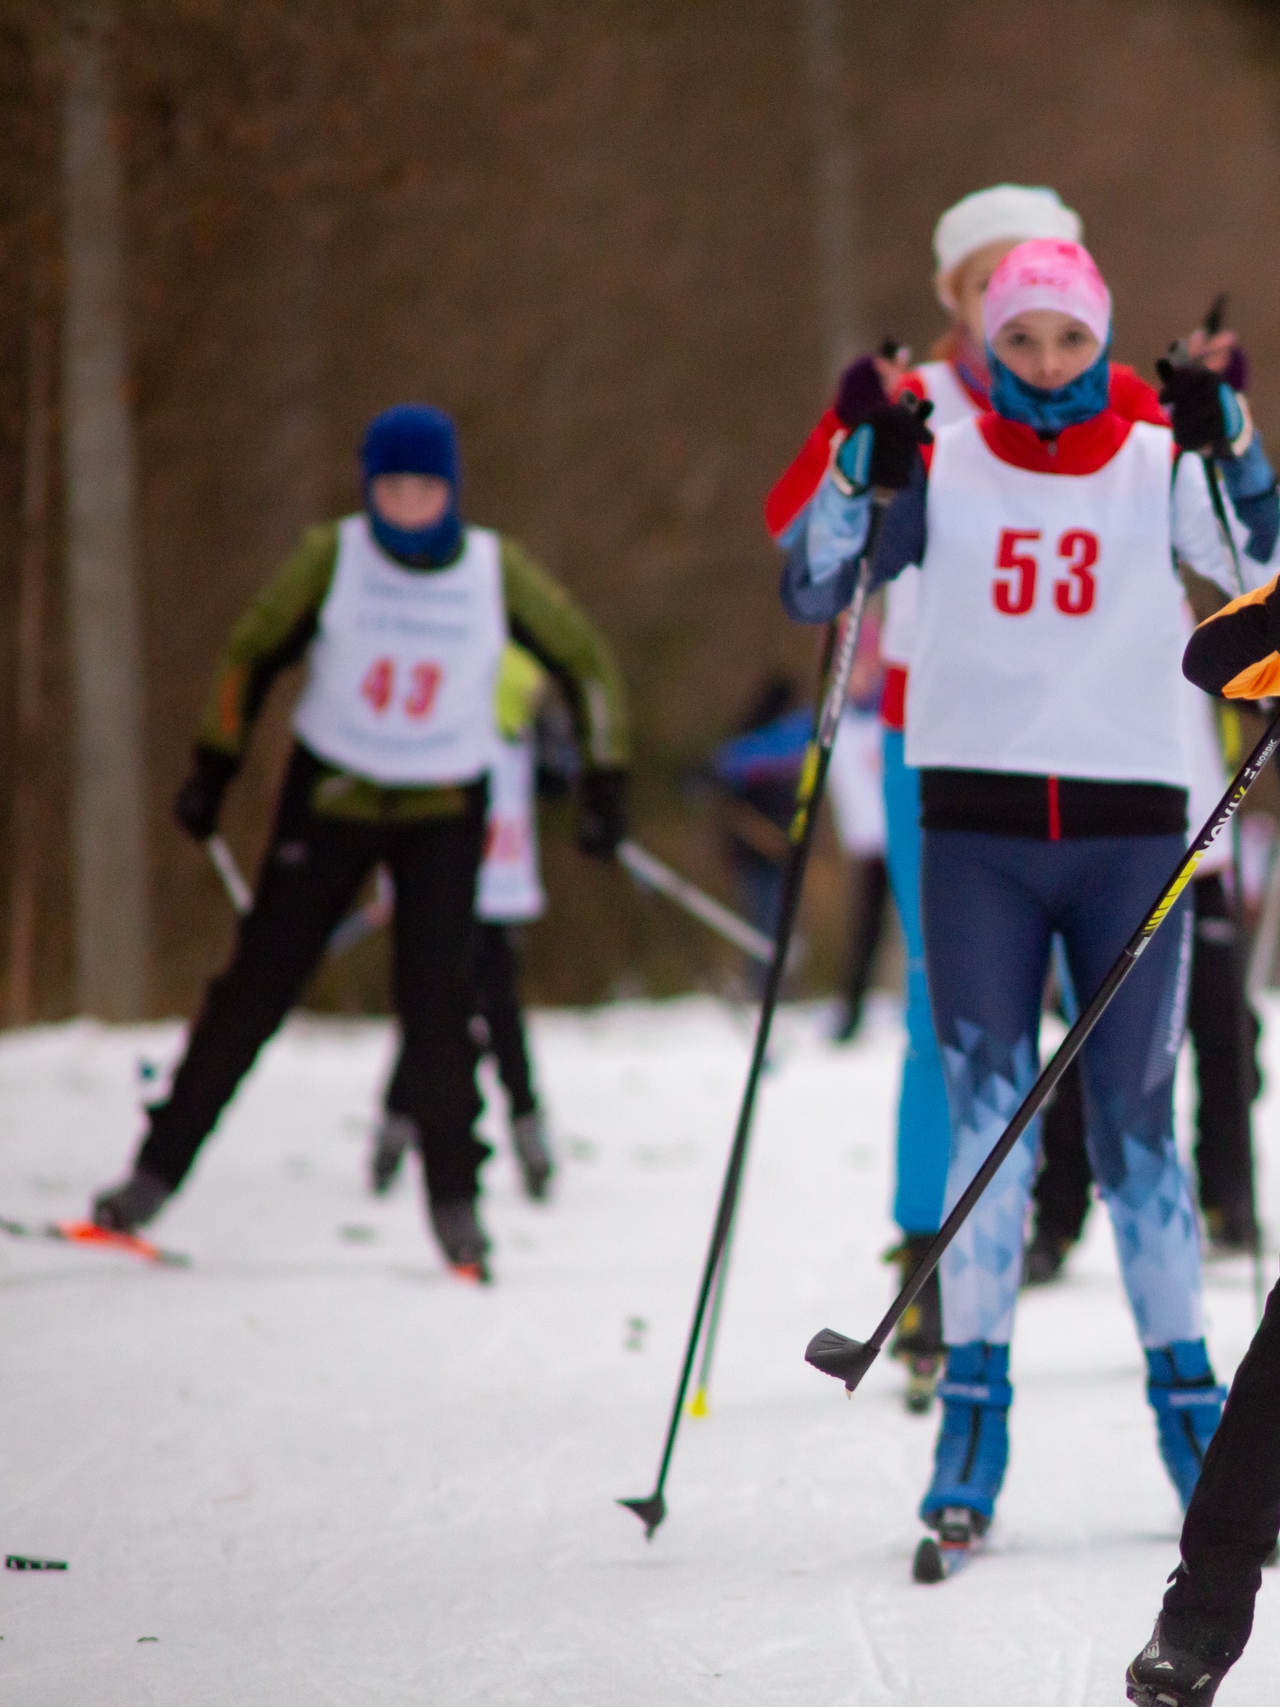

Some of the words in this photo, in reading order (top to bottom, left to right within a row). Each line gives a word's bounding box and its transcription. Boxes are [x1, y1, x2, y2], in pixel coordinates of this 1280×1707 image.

[992, 527, 1101, 617] 53
[359, 656, 444, 721] 43
[1255, 739, 1278, 767] NORDIC
